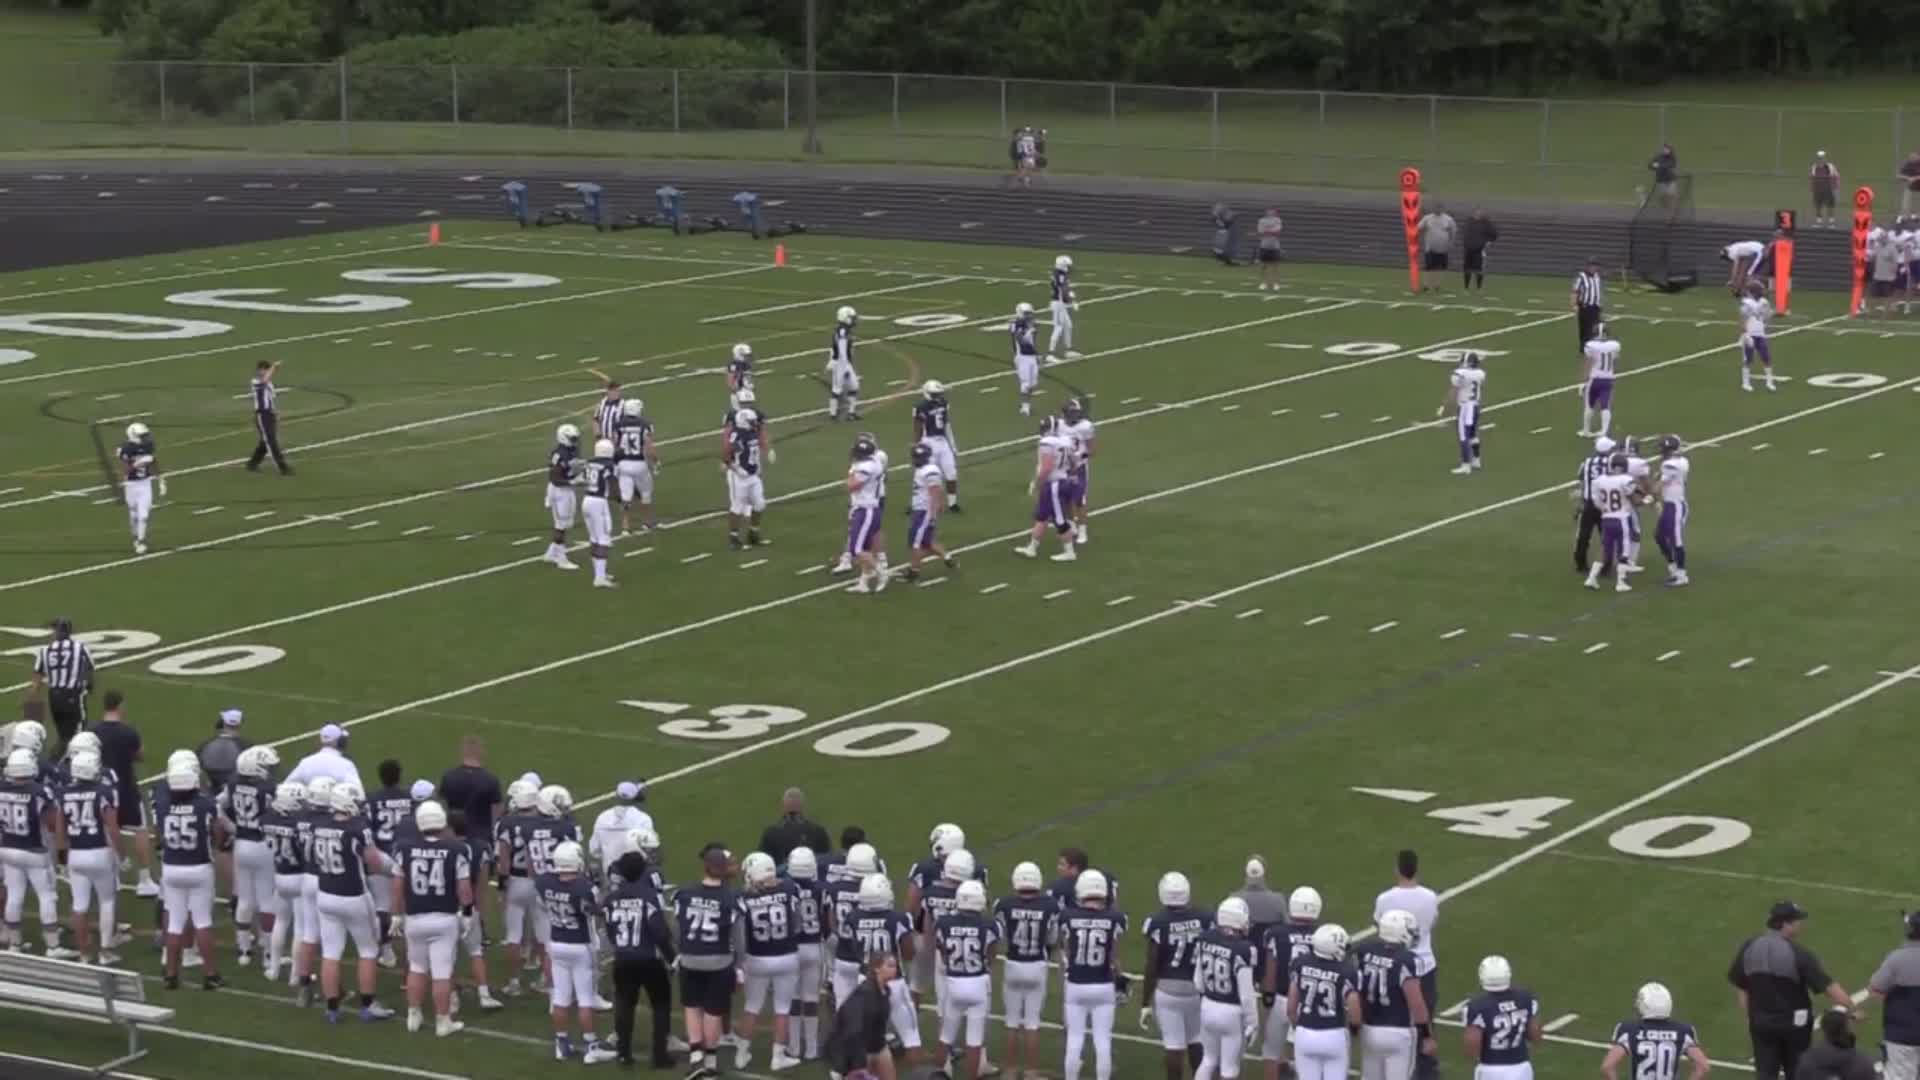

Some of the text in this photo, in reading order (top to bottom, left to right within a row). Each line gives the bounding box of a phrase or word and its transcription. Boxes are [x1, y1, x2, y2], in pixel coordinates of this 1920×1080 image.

[620, 434, 641, 455] 43
[63, 802, 98, 836] 34
[164, 815, 198, 850] 65
[314, 838, 346, 875] 96
[410, 860, 446, 896] 64
[611, 909, 642, 947] 37
[686, 908, 720, 942] 75
[750, 906, 787, 941] 58
[1012, 920, 1040, 956] 41
[856, 931, 891, 964] 70
[946, 938, 982, 972] 26
[1075, 929, 1108, 966] 16
[1200, 955, 1232, 994] 28
[1364, 965, 1390, 1006] 71
[1299, 977, 1336, 1016] 73
[1490, 1009, 1528, 1049] 27
[1637, 1041, 1674, 1080] 20
